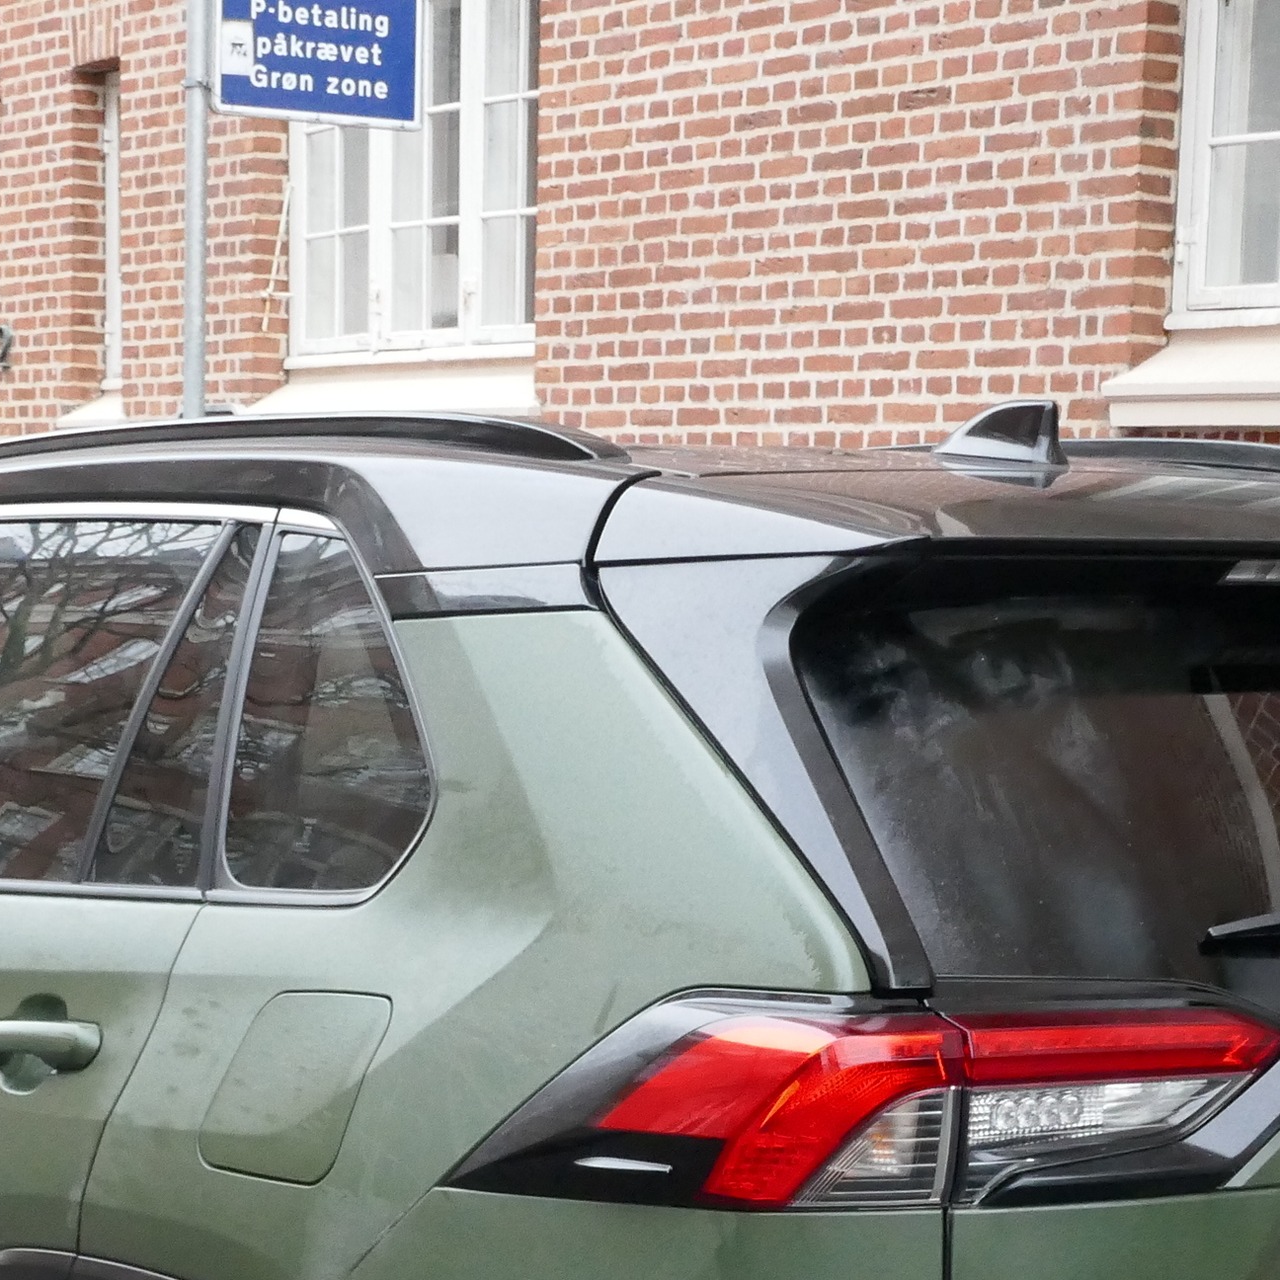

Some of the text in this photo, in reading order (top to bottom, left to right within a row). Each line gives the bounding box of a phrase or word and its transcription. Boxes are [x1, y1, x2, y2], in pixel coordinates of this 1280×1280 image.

[250, 0, 390, 38] P-betaling
[256, 34, 383, 66] påkrævet
[250, 65, 388, 99] Grøn zone
